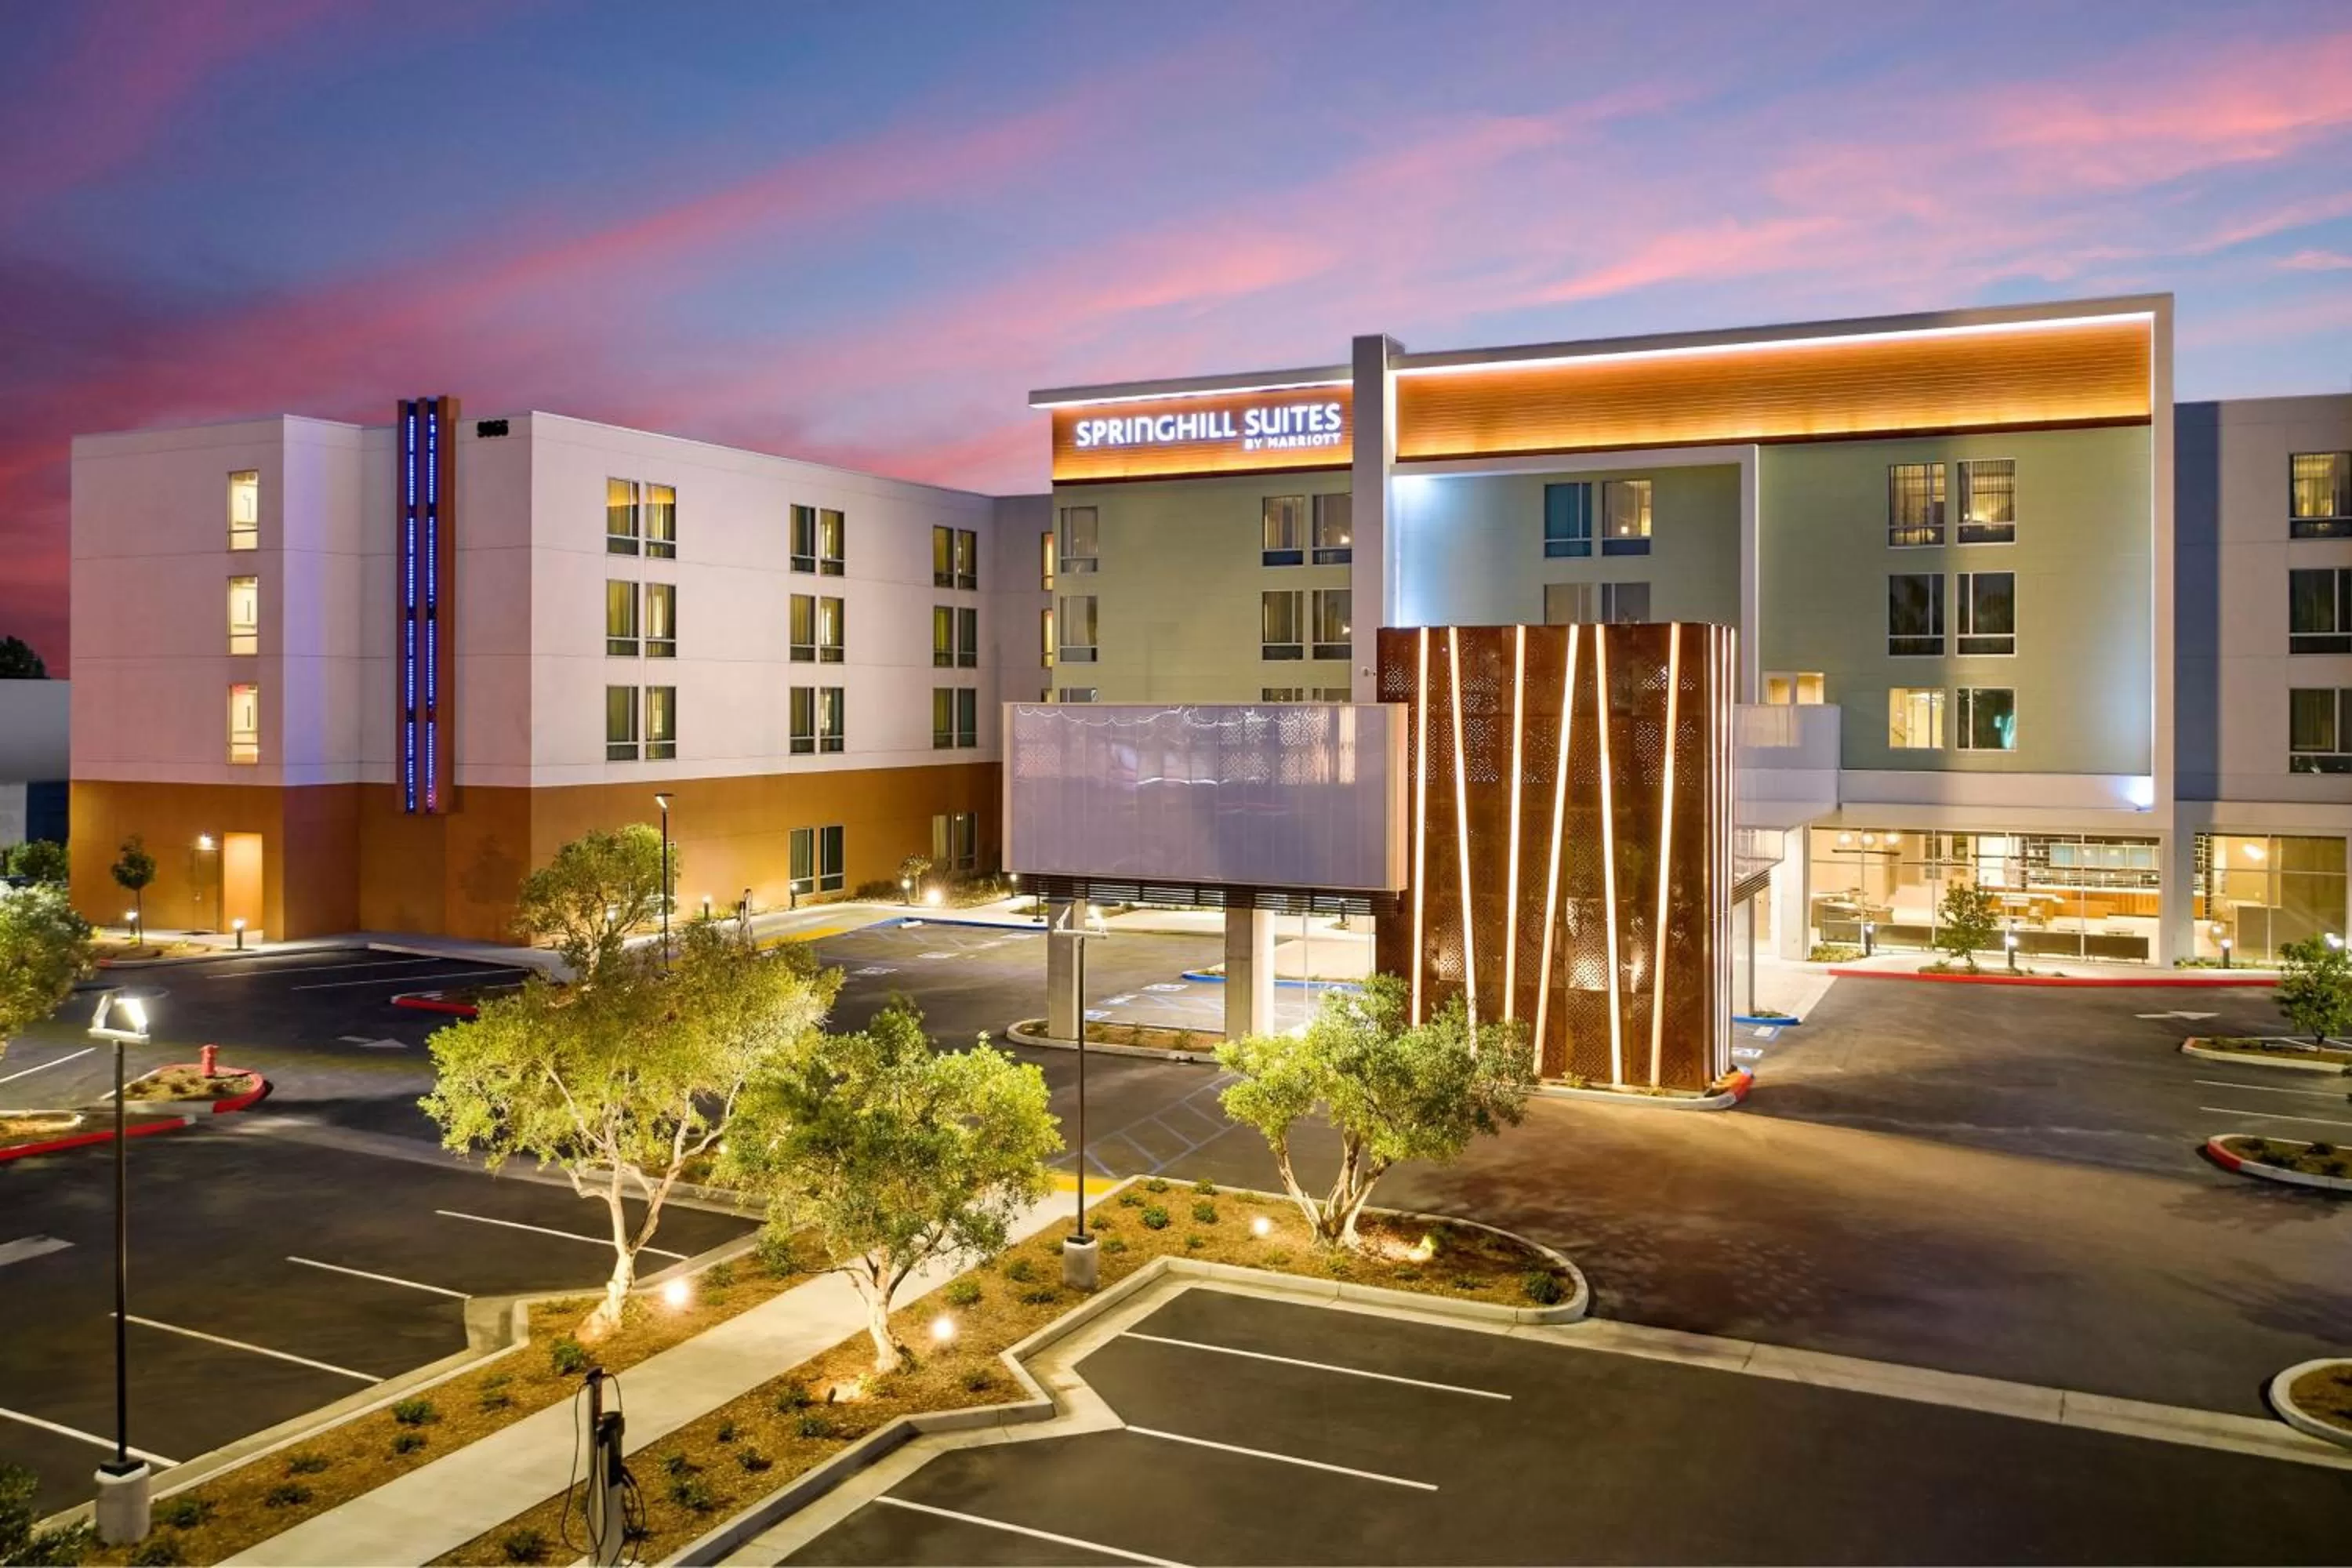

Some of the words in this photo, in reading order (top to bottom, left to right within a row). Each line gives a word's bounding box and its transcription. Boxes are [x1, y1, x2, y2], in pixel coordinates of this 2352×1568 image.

[1076, 410, 1237, 447] SPRINGHILL
[1244, 402, 1341, 436] SUITES
[1244, 437, 1263, 450] BY
[1268, 432, 1341, 448] MARRIOTT
